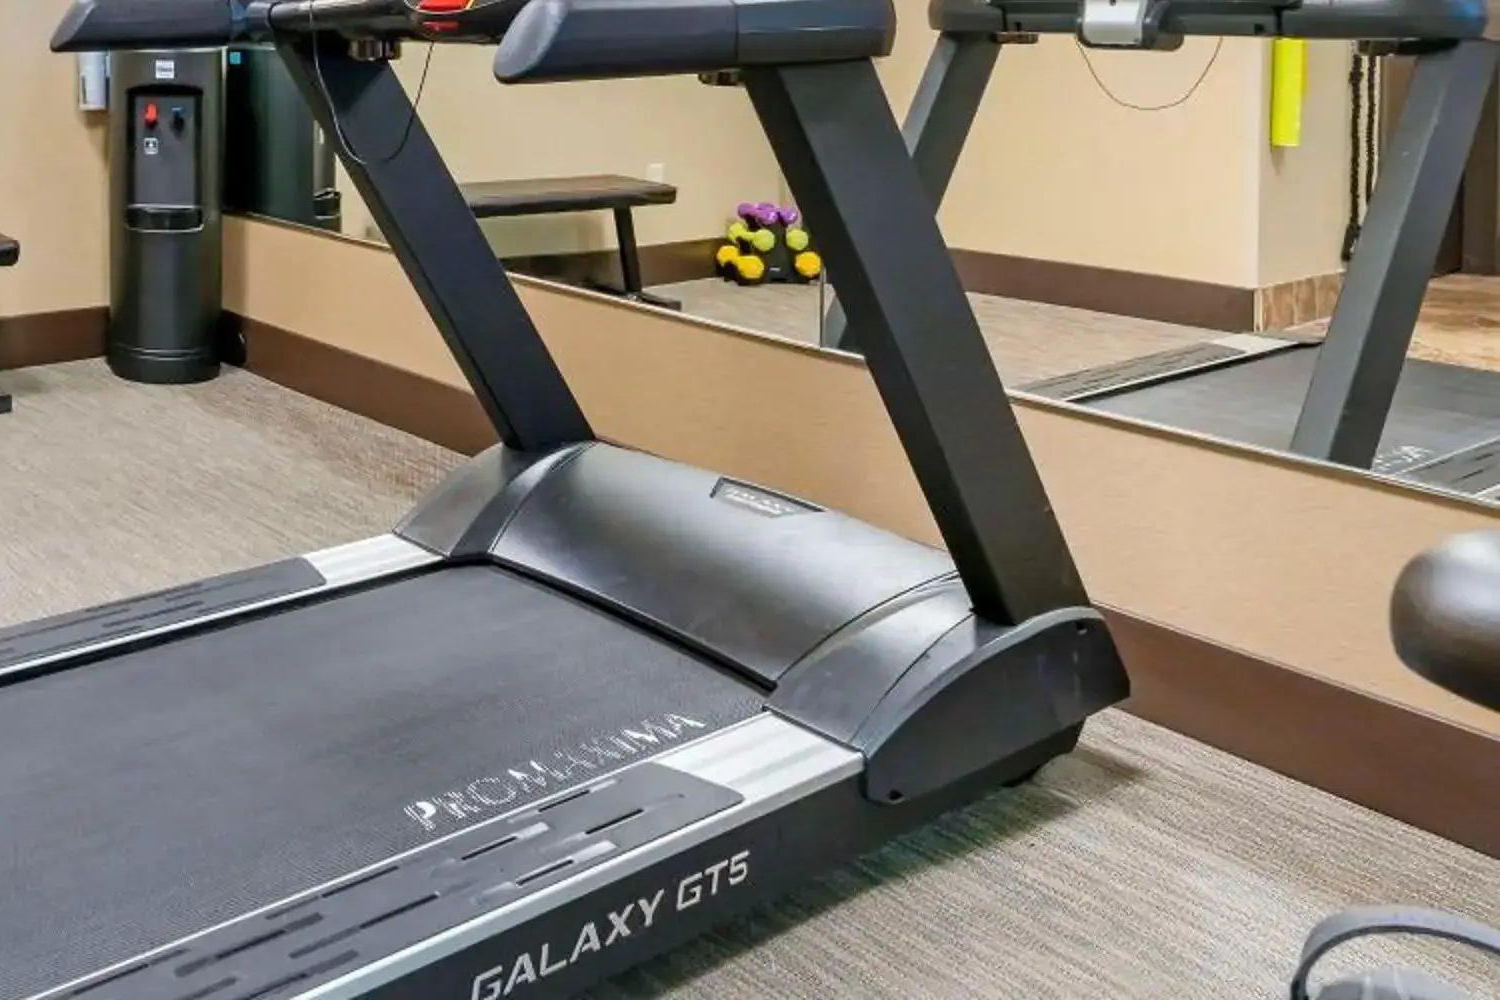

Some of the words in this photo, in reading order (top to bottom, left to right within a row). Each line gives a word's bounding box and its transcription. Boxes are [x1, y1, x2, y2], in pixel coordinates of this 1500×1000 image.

[403, 712, 707, 832] PROMAXIMA
[470, 888, 666, 1000] GALAXY
[675, 850, 751, 912] GT5
